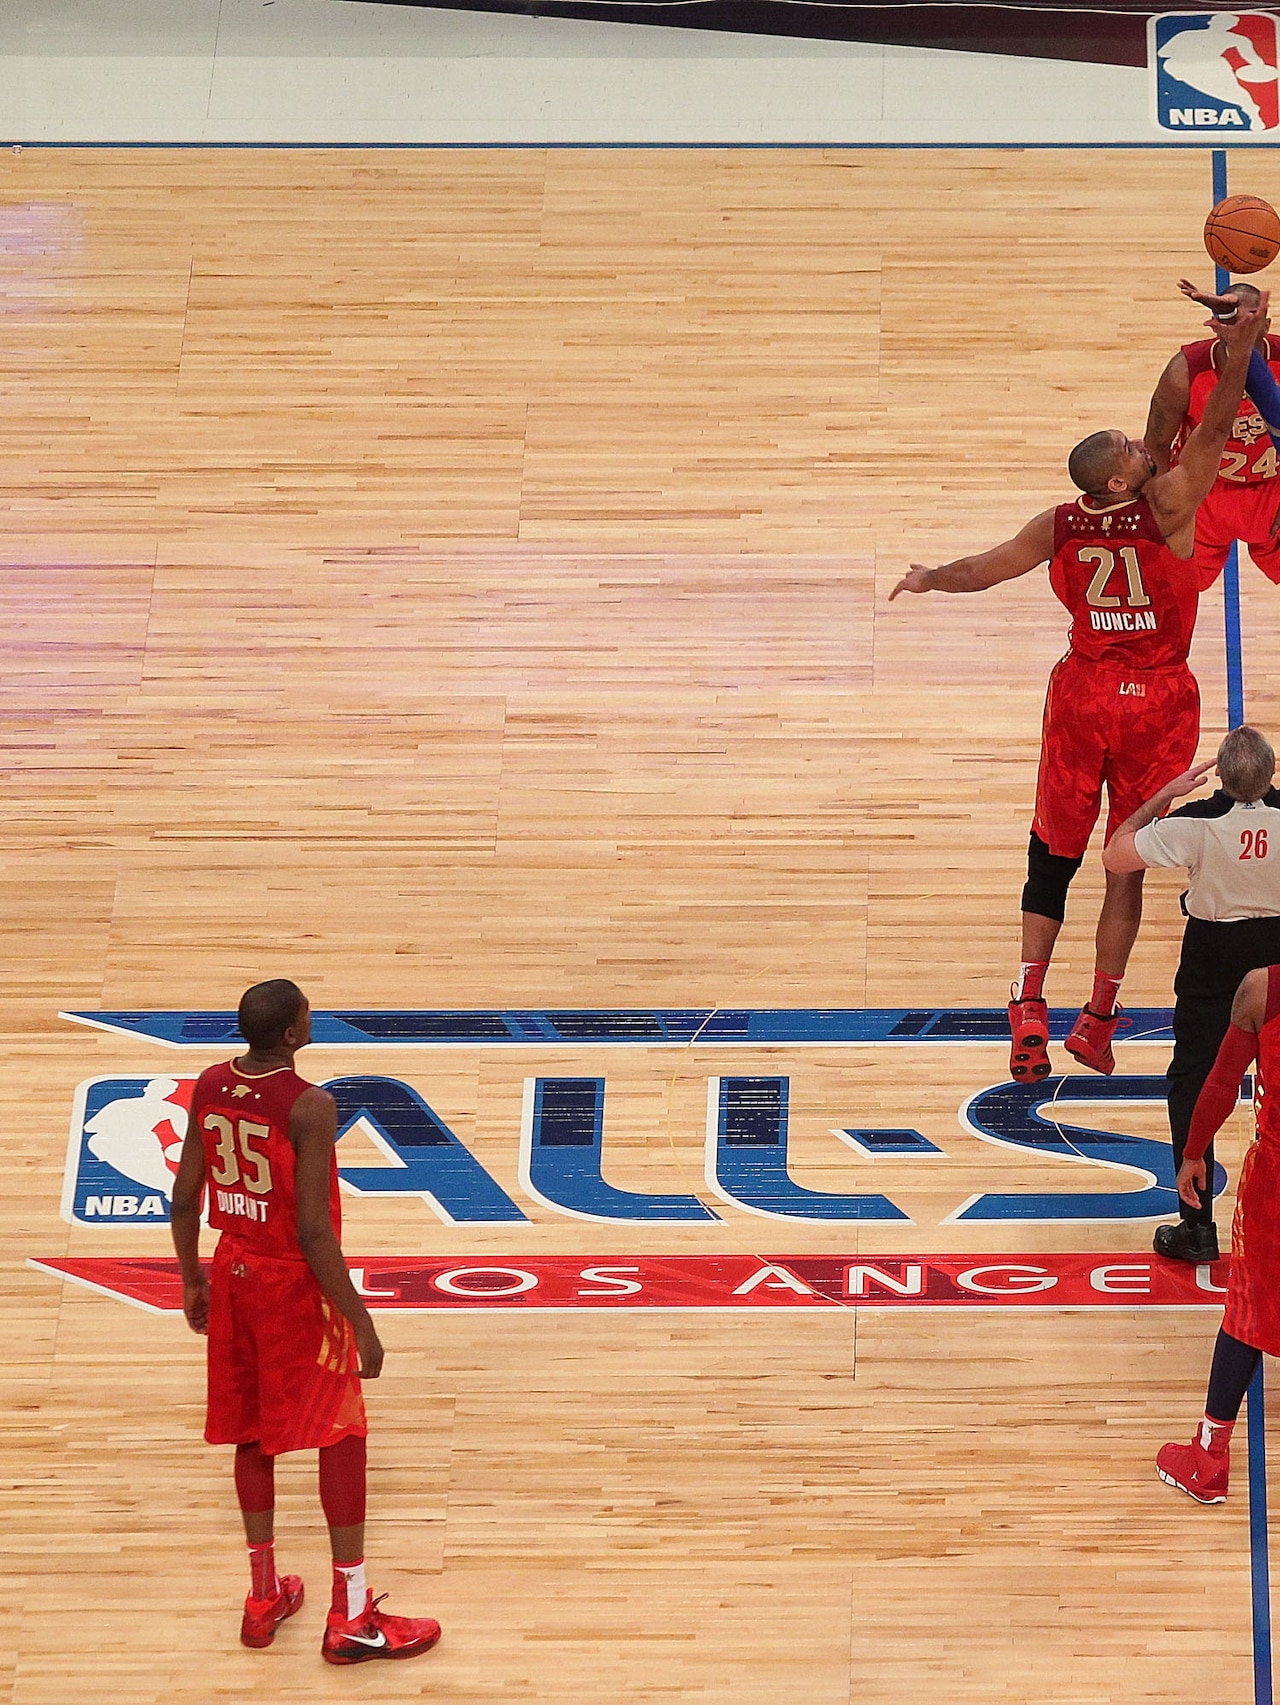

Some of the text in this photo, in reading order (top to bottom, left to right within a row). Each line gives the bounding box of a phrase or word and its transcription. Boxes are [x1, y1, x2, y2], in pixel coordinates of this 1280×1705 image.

[1169, 108, 1244, 126] NBA
[1231, 413, 1268, 439] ES
[1218, 446, 1280, 483] 24
[1077, 546, 1151, 608] 21
[1089, 610, 1157, 631] DUNCAN
[1239, 828, 1268, 861] 26
[203, 1113, 273, 1195] 35
[84, 1196, 166, 1217] NBA
[348, 1266, 644, 1298] LOS
